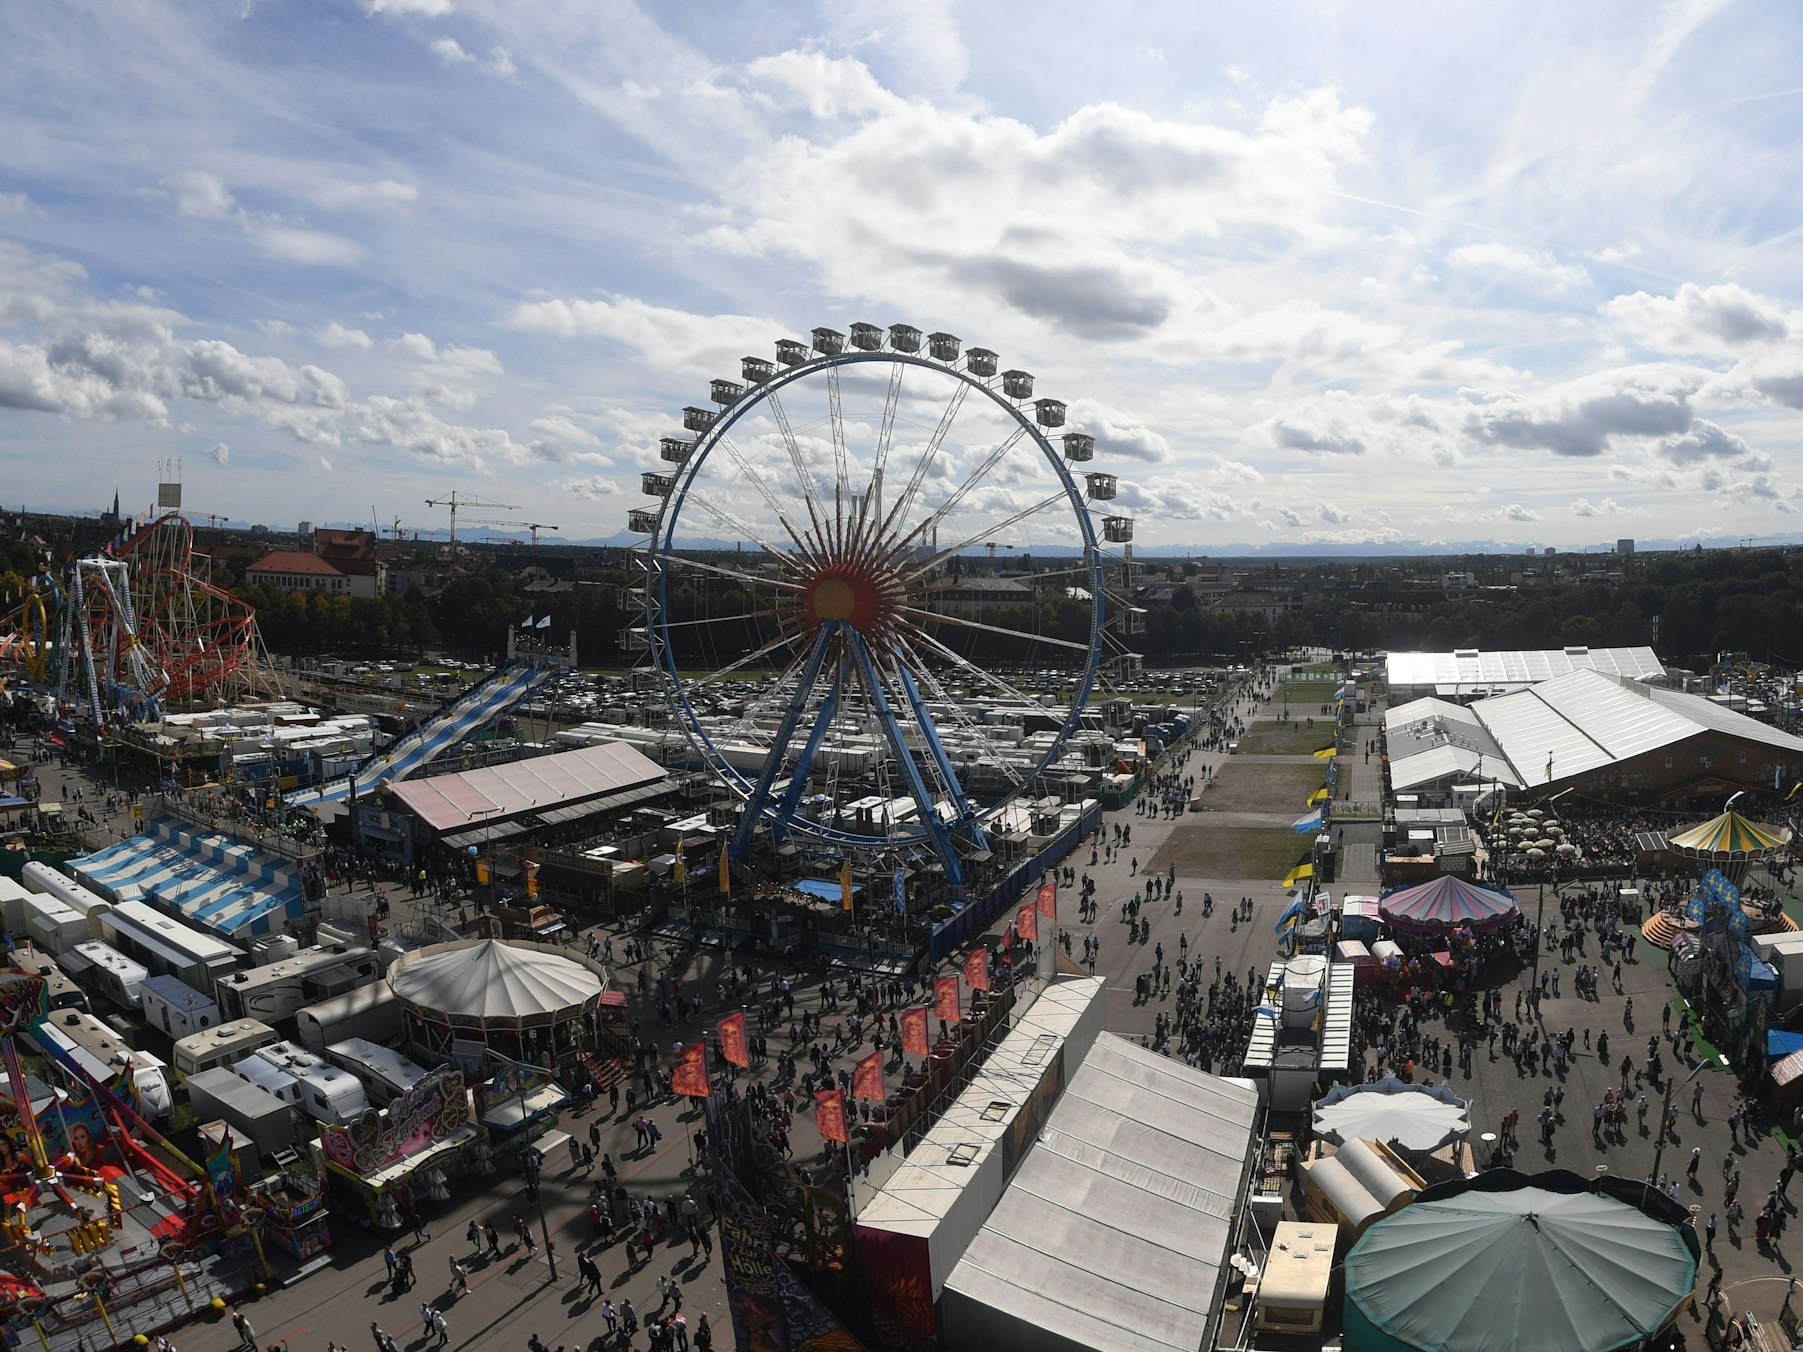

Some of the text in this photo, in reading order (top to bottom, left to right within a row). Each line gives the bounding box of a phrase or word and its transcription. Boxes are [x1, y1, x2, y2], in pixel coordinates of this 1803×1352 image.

[427, 761, 460, 773] Münchner
[720, 1215, 769, 1251] Fahrt
[730, 1253, 773, 1275] Hölle
